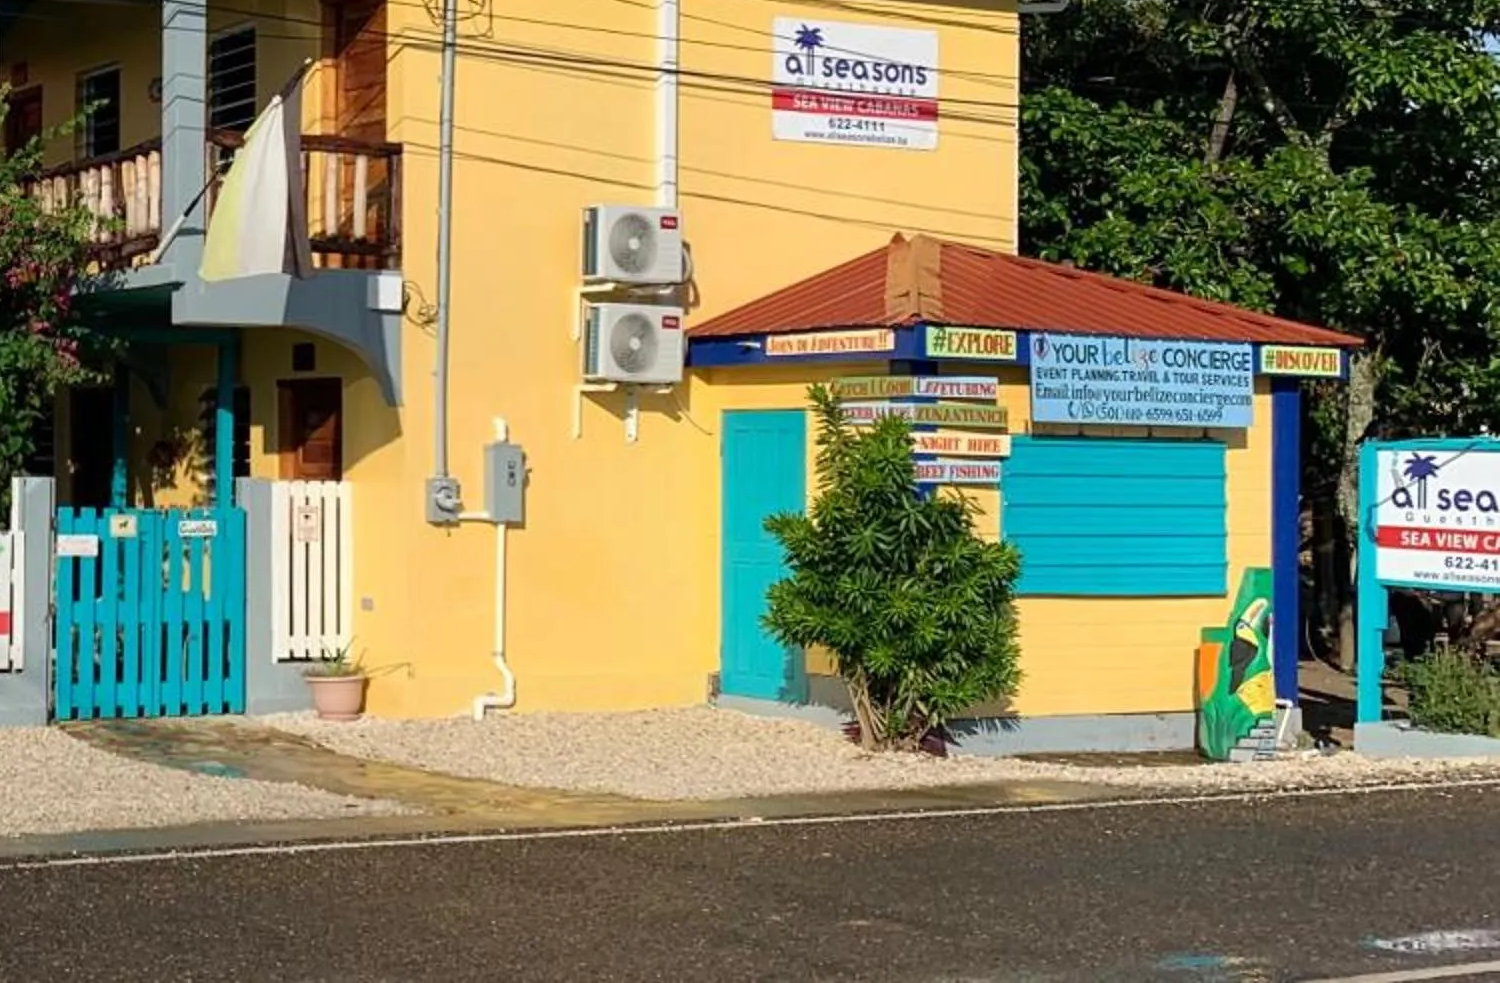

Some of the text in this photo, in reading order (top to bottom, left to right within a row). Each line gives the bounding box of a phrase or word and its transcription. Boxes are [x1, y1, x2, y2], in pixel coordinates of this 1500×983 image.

[822, 56, 927, 85] seasons
[793, 94, 919, 117] SEA VIEW CABANAS
[828, 118, 885, 132] 622-4111
[933, 328, 1013, 356] #EXPLORE
[1052, 343, 1099, 365] YOUR
[1161, 347, 1251, 371] CONCIERGE
[1265, 350, 1337, 372] #DISCOVER
[1036, 369, 1068, 381] EVENT
[1174, 373, 1199, 385] TOUR
[1201, 375, 1249, 388] SERVICES
[921, 437, 1002, 452] NIGHT HIKE
[950, 465, 999, 479] FISHING
[1400, 530, 1431, 546] SEA
[1436, 532, 1479, 550] VIEW
